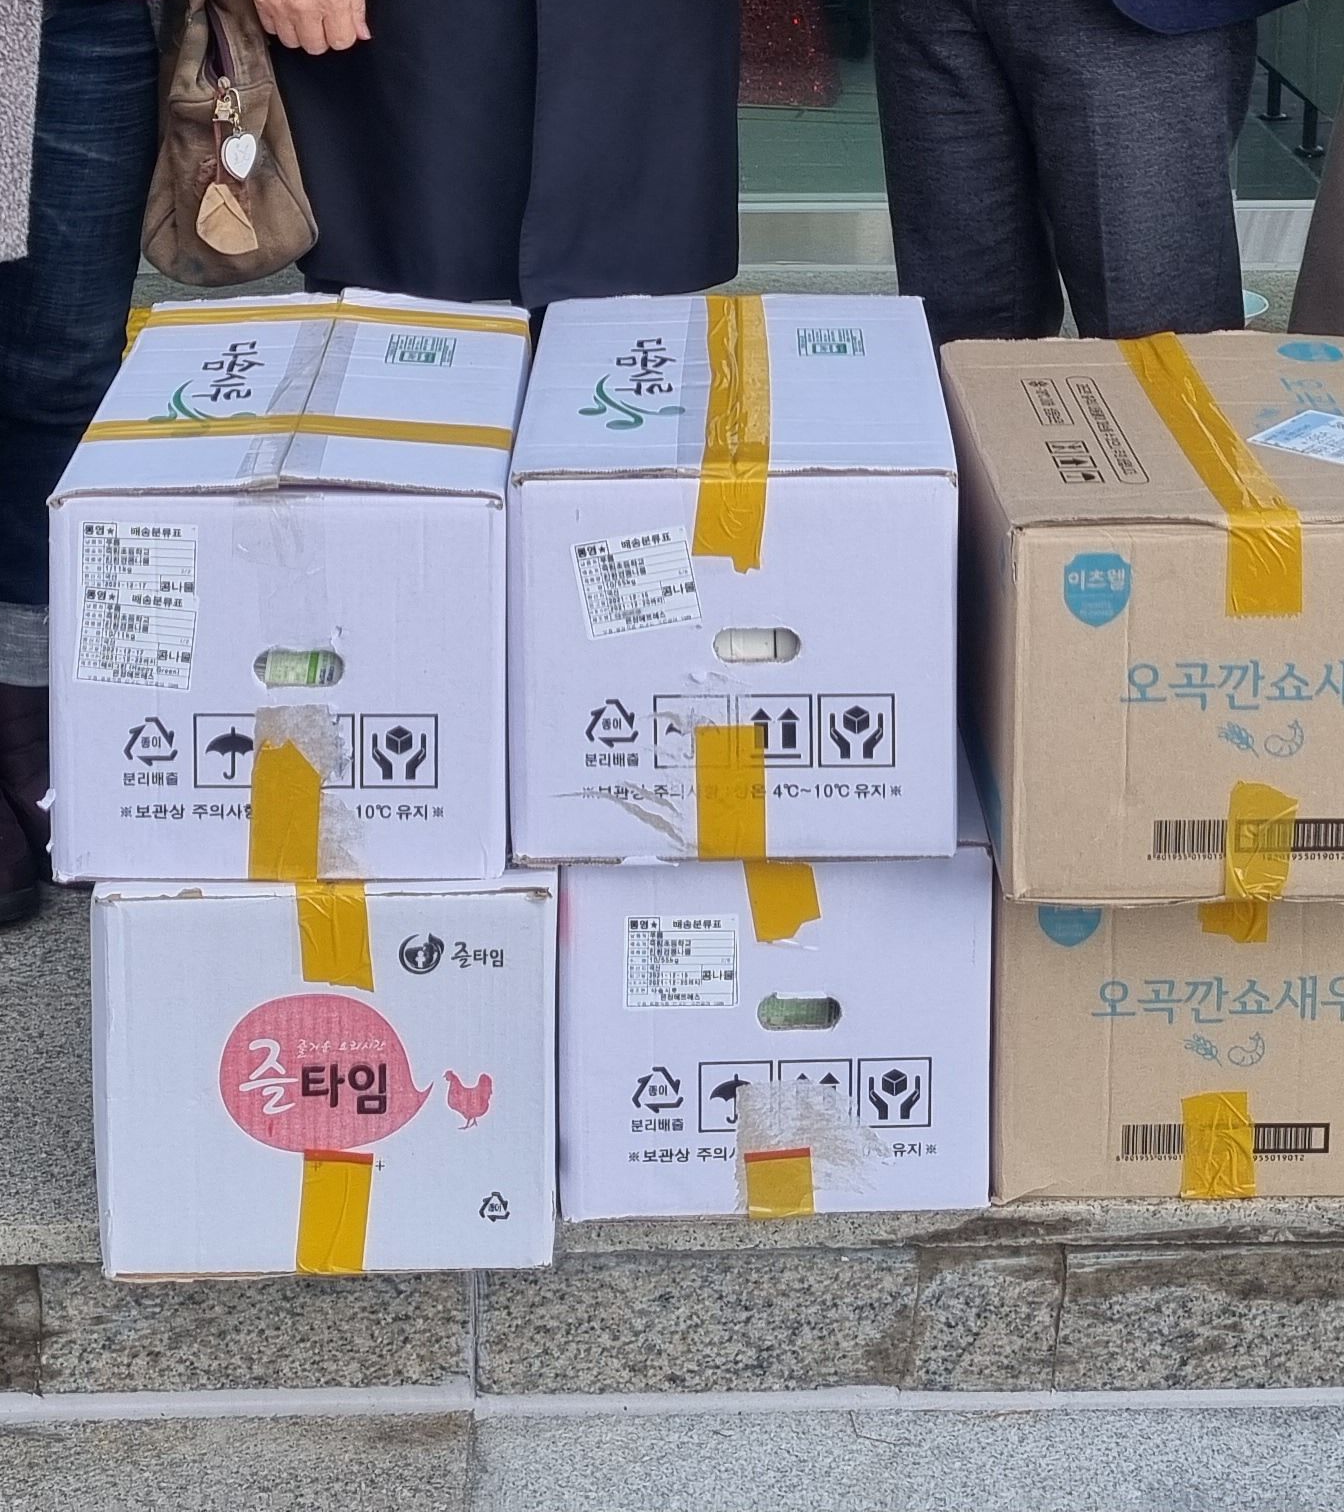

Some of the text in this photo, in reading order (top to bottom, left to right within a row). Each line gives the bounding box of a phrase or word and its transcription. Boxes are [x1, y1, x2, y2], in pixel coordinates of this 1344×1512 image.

[584, 752, 640, 769] 분리배출
[122, 771, 179, 787] 분리배출
[451, 942, 505, 968] 즐타임
[239, 1038, 387, 1115] 즐타임
[631, 1118, 684, 1132] 분리배출
